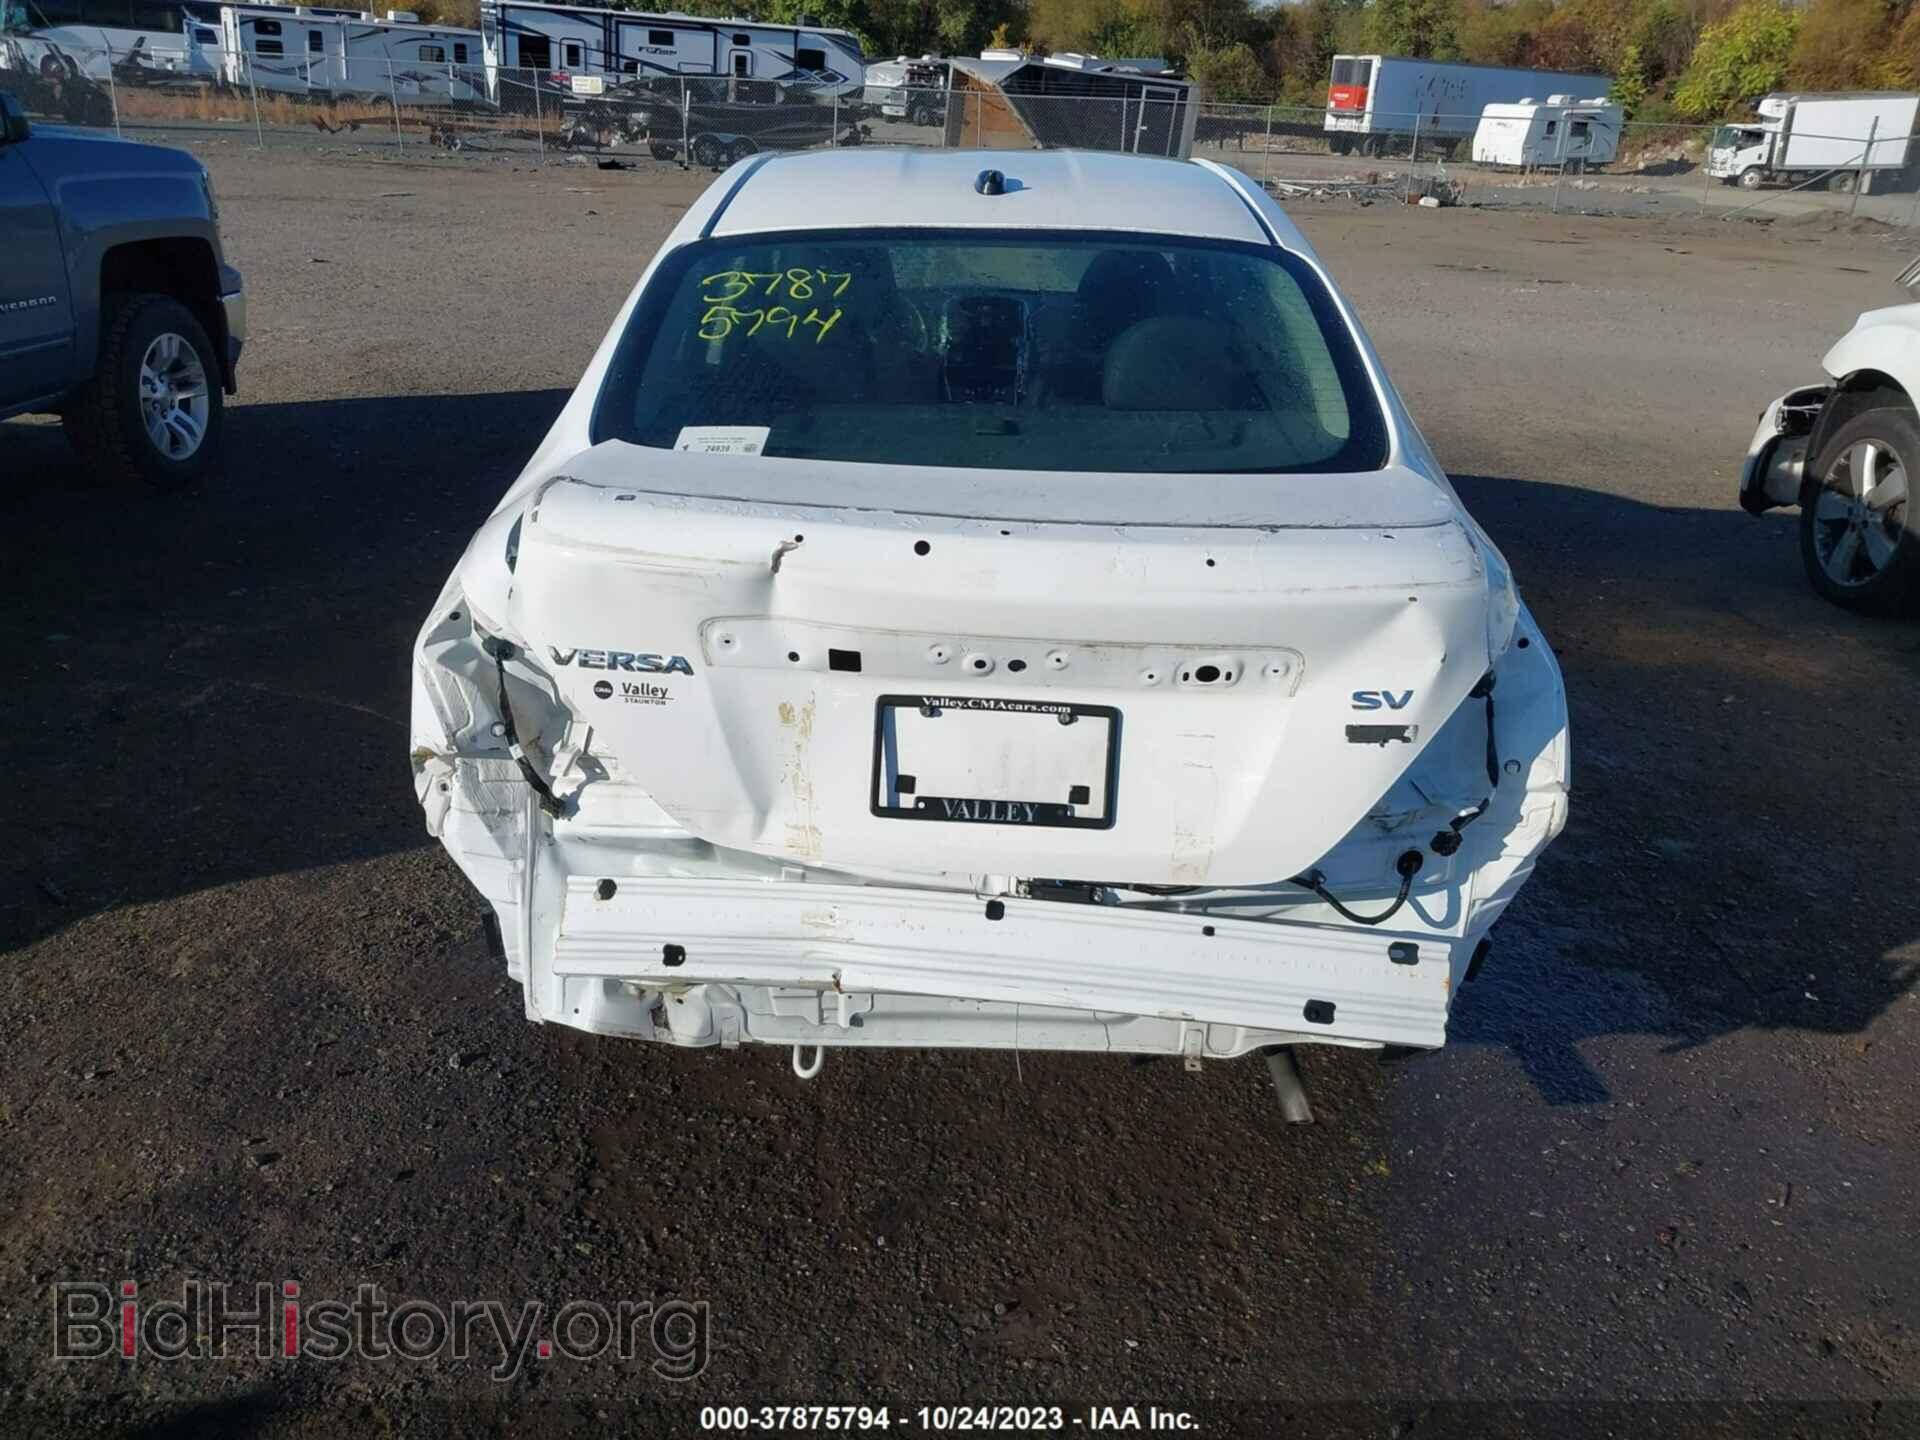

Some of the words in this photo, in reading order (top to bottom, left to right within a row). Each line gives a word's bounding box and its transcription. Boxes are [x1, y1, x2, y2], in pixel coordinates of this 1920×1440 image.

[702, 268, 851, 302] 3787
[698, 306, 842, 344] 5794
[547, 645, 695, 676] VERSA
[622, 682, 669, 699] Valley
[624, 697, 666, 706] STAUNTON
[1351, 689, 1414, 710] SV
[922, 696, 1072, 714] Valley.CMAcars.com
[942, 799, 1040, 824] VALLEY
